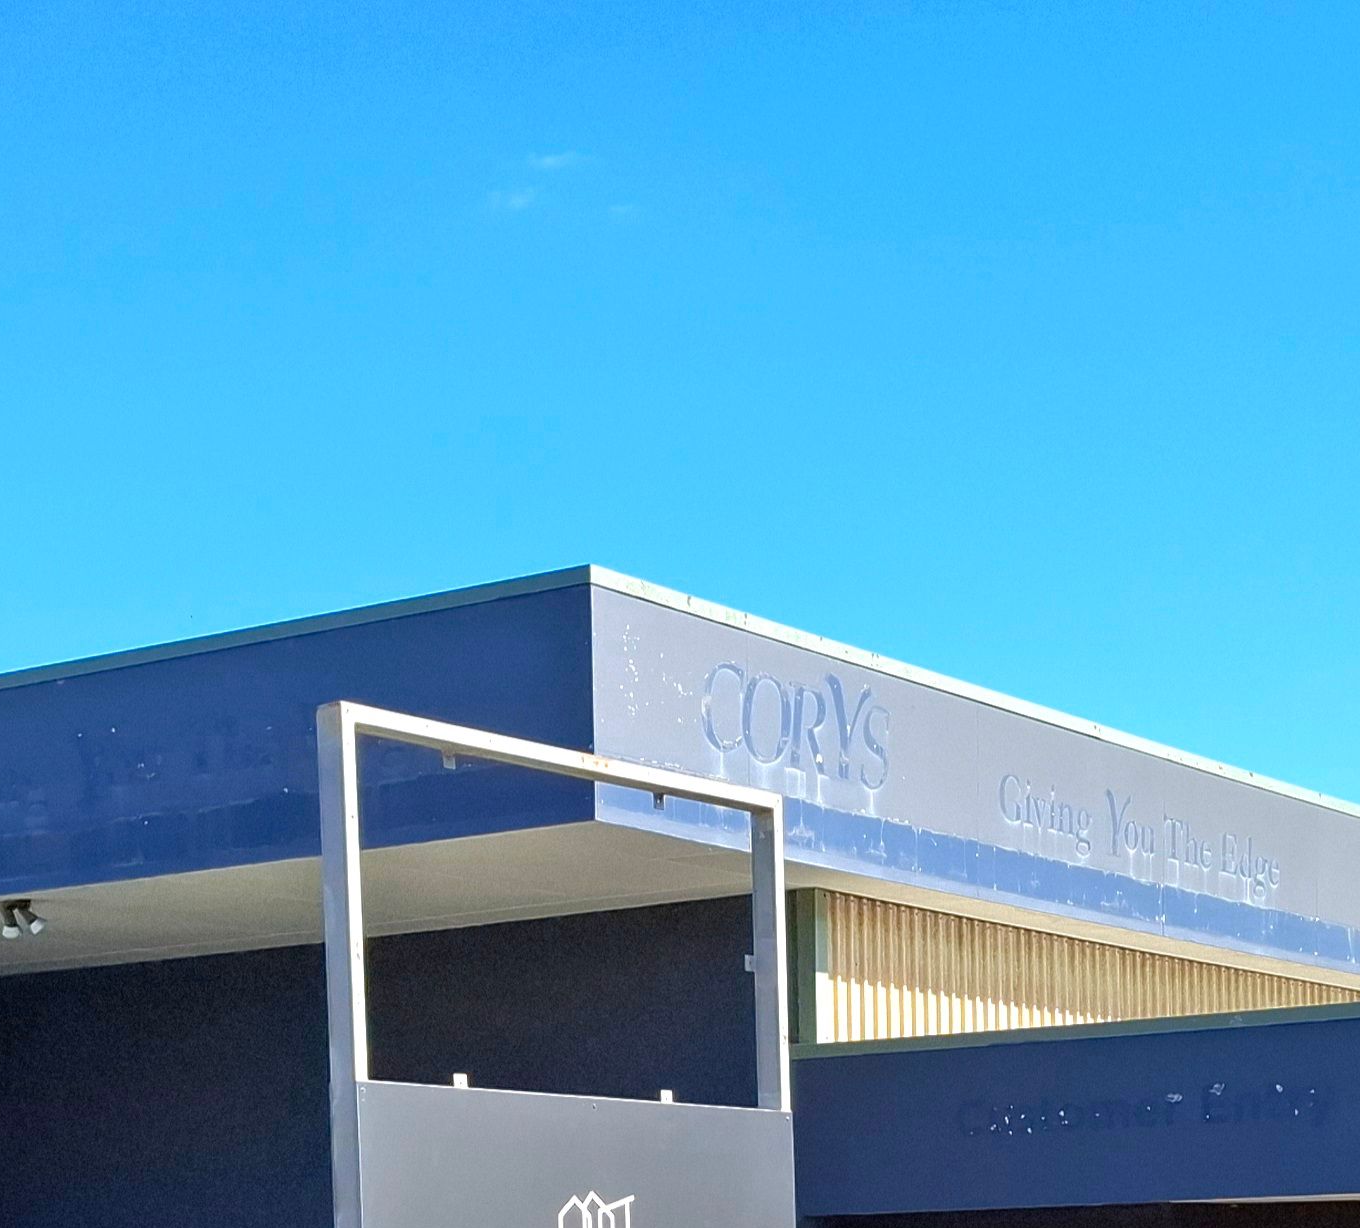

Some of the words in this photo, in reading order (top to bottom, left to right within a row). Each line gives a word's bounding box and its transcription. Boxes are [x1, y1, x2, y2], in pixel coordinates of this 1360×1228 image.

[702, 661, 889, 790] CORYS
[999, 774, 1092, 858] Giving
[1105, 787, 1155, 857] You
[1163, 812, 1213, 871] The
[1219, 831, 1280, 899] Edge
